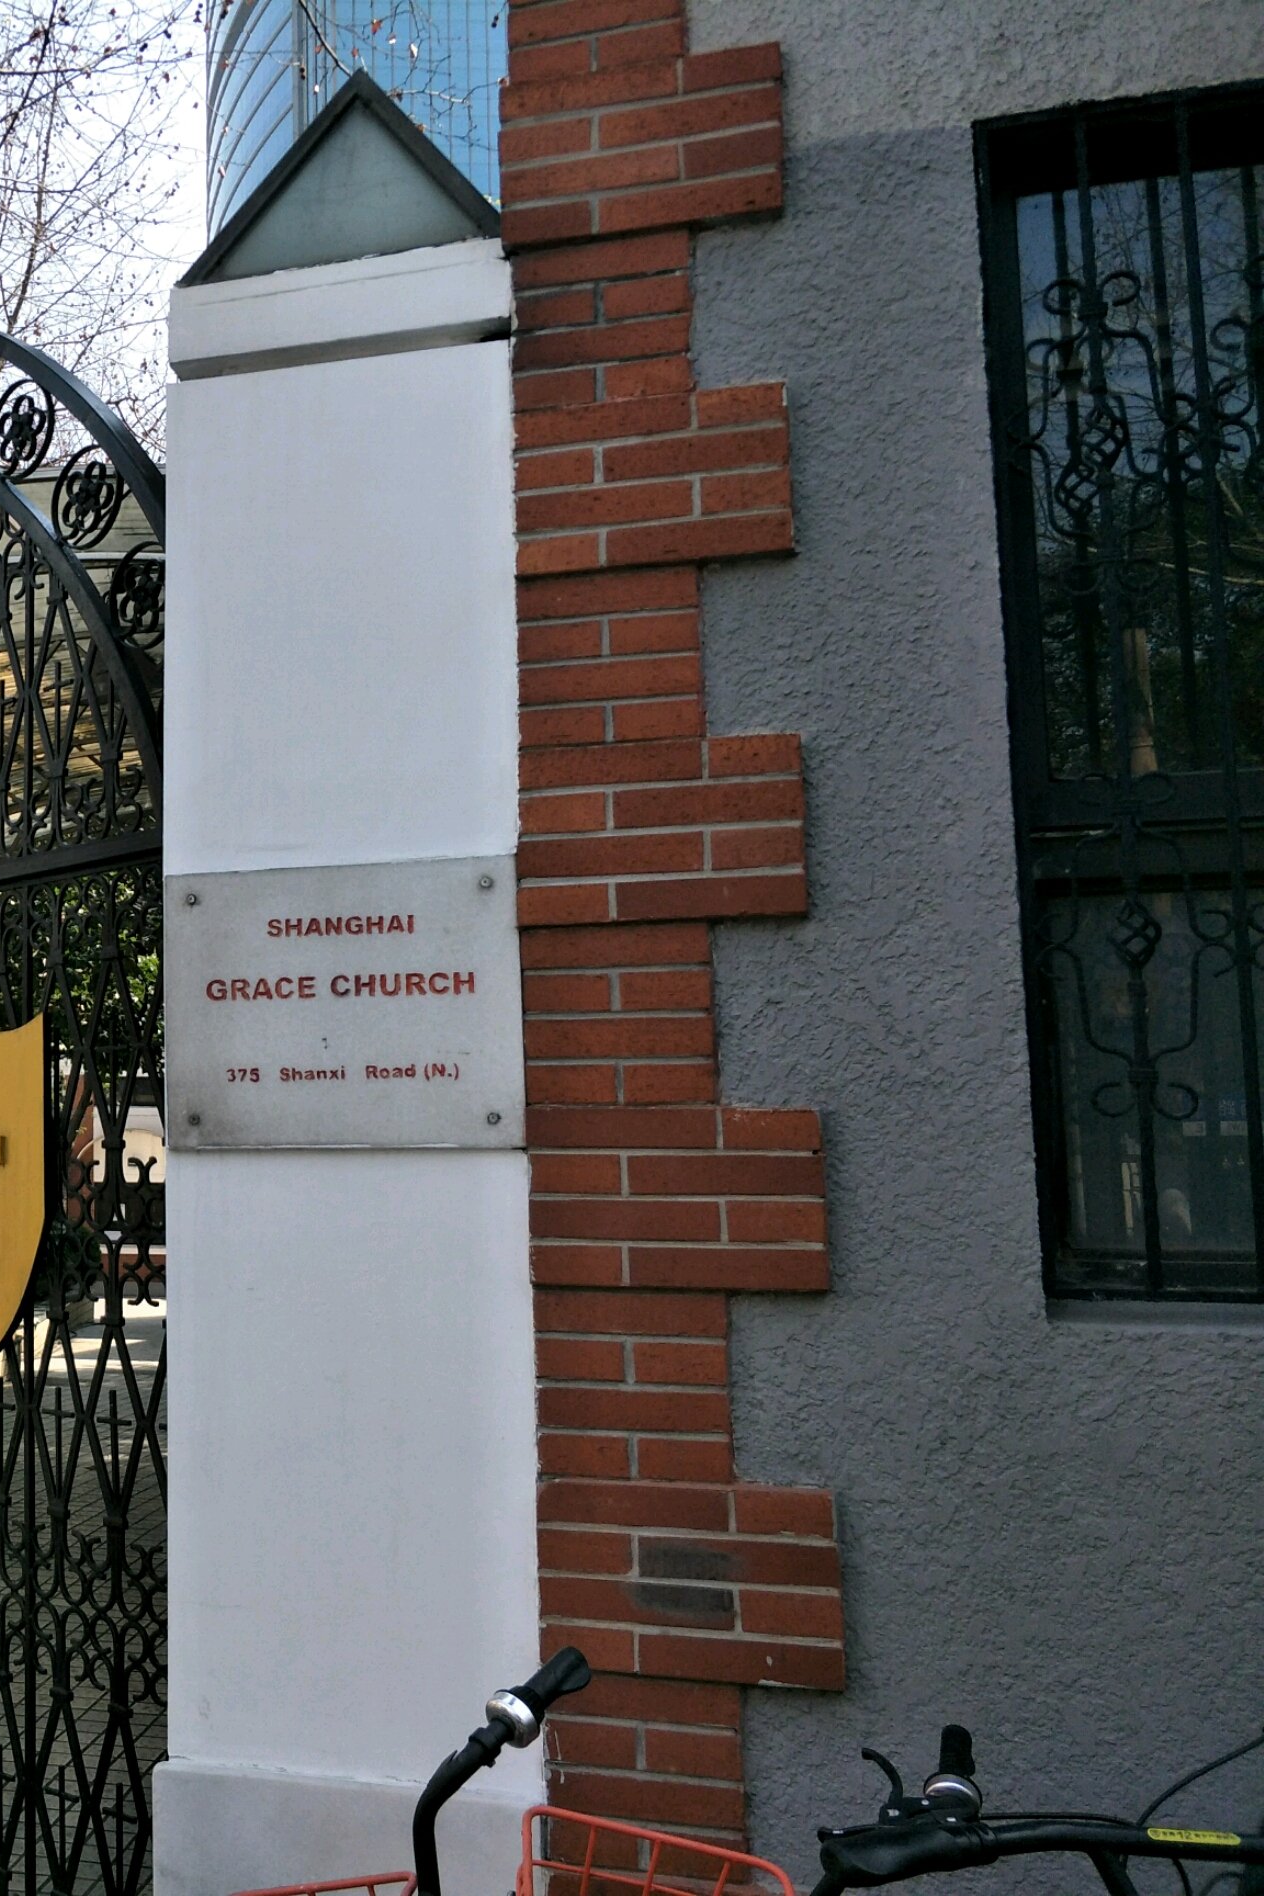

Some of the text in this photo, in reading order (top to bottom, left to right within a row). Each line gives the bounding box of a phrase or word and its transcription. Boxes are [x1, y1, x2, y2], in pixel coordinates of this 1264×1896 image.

[267, 914, 415, 938] SHANGHAI
[206, 971, 476, 1001] GRACE CHURCH
[226, 1067, 260, 1083] 375
[279, 1066, 346, 1082] Shanxi
[365, 1064, 417, 1080] Road
